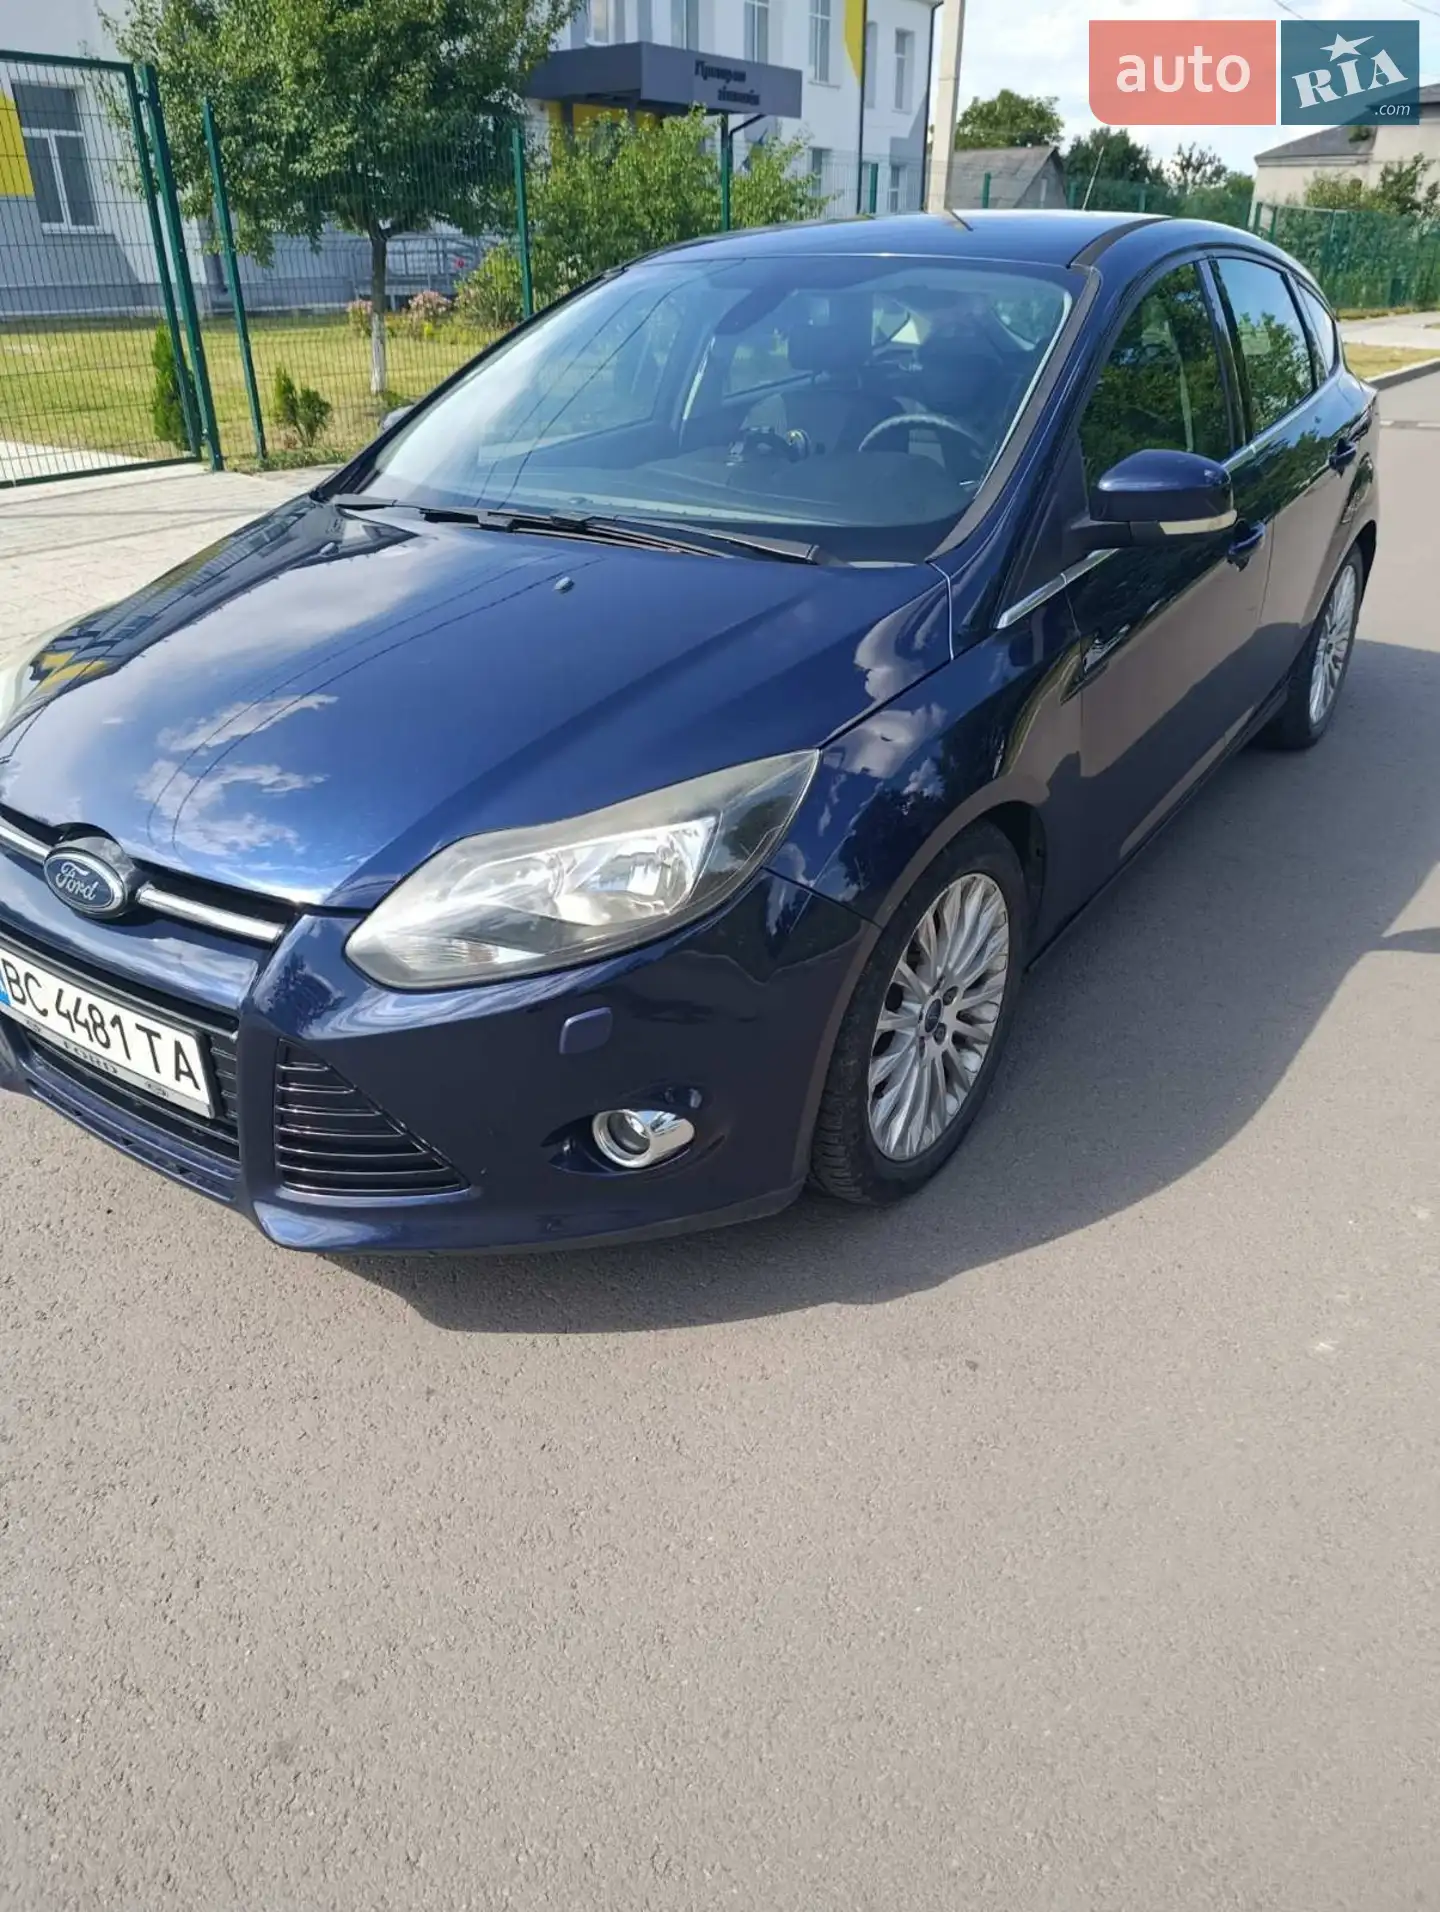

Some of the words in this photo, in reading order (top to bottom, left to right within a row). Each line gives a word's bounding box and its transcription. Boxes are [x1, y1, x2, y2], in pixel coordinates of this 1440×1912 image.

[55, 861, 99, 901] Ford
[1, 958, 49, 1018] BC
[55, 988, 132, 1061] 4481
[135, 1022, 202, 1092] TA
